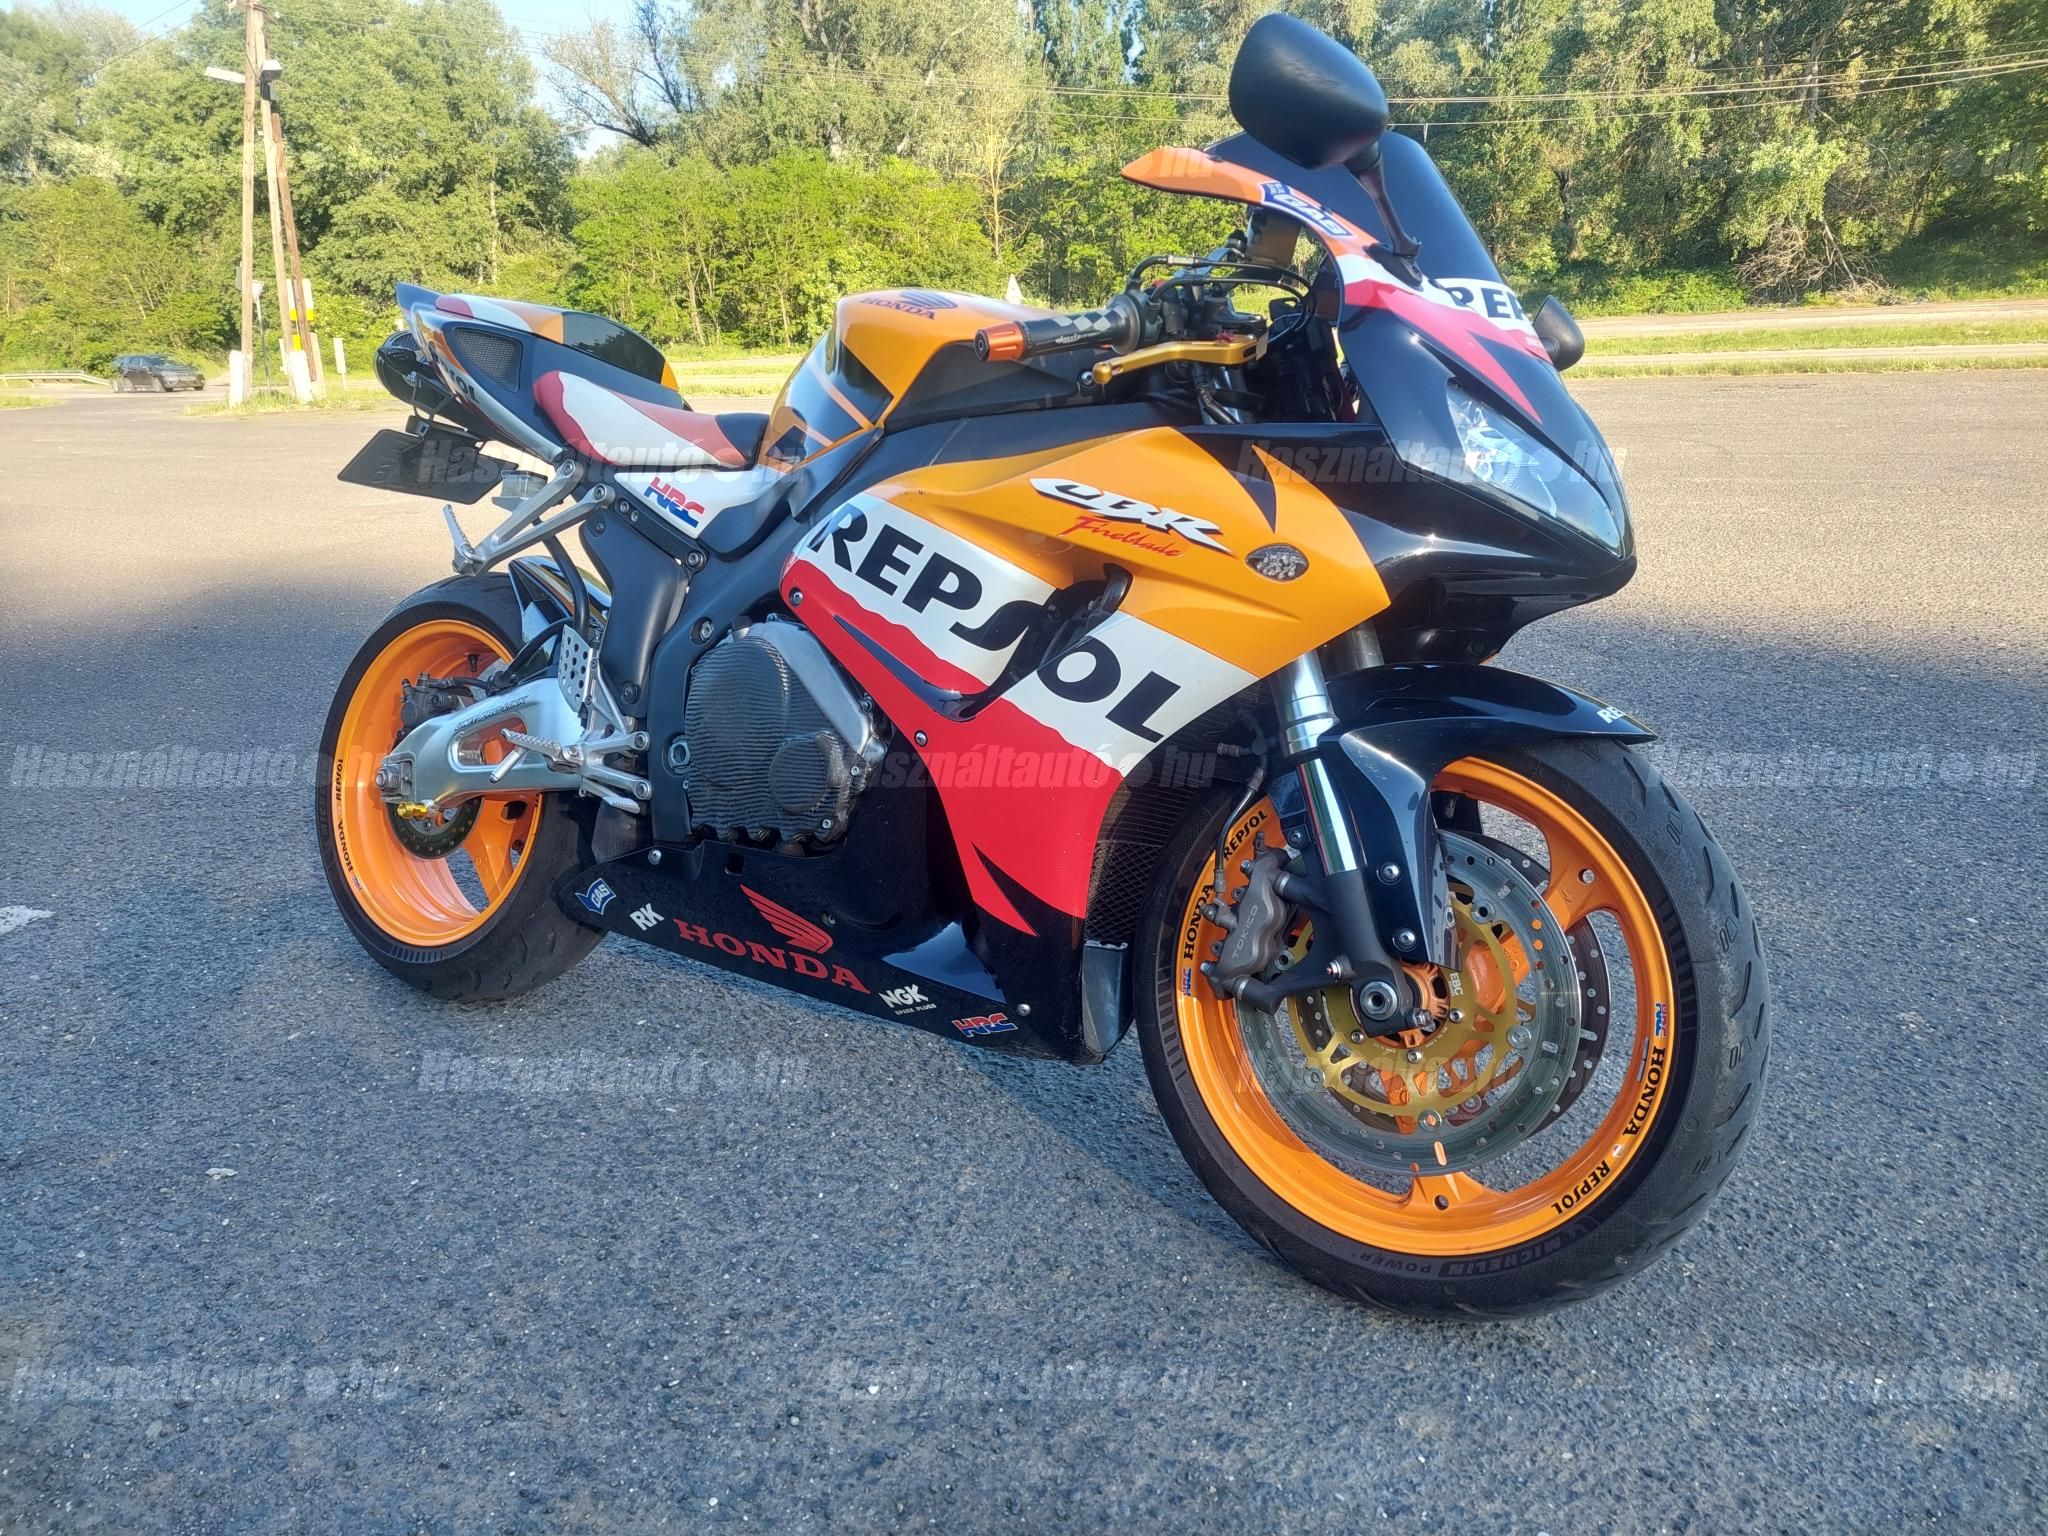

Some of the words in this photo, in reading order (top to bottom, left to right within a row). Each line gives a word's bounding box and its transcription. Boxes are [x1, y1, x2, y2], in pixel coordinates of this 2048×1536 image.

[860, 298, 935, 320] HONDA
[643, 476, 705, 529] HRC
[1029, 477, 1240, 560] CBR
[1057, 516, 1183, 557] Fireblade
[808, 502, 1182, 744] REPSOL
[335, 758, 344, 801] REPSOL
[337, 819, 354, 873] HONDA
[1223, 810, 1268, 861] REPSOL
[591, 883, 611, 909] GAS
[629, 903, 665, 931] RK
[673, 918, 872, 994] HONDA
[878, 983, 929, 1009] NGK
[951, 1012, 1019, 1038] HRC
[1622, 1046, 1666, 1137] HONDA
[1551, 1159, 1612, 1216] REPSOL
[1447, 1237, 1562, 1277] MICHELIN
